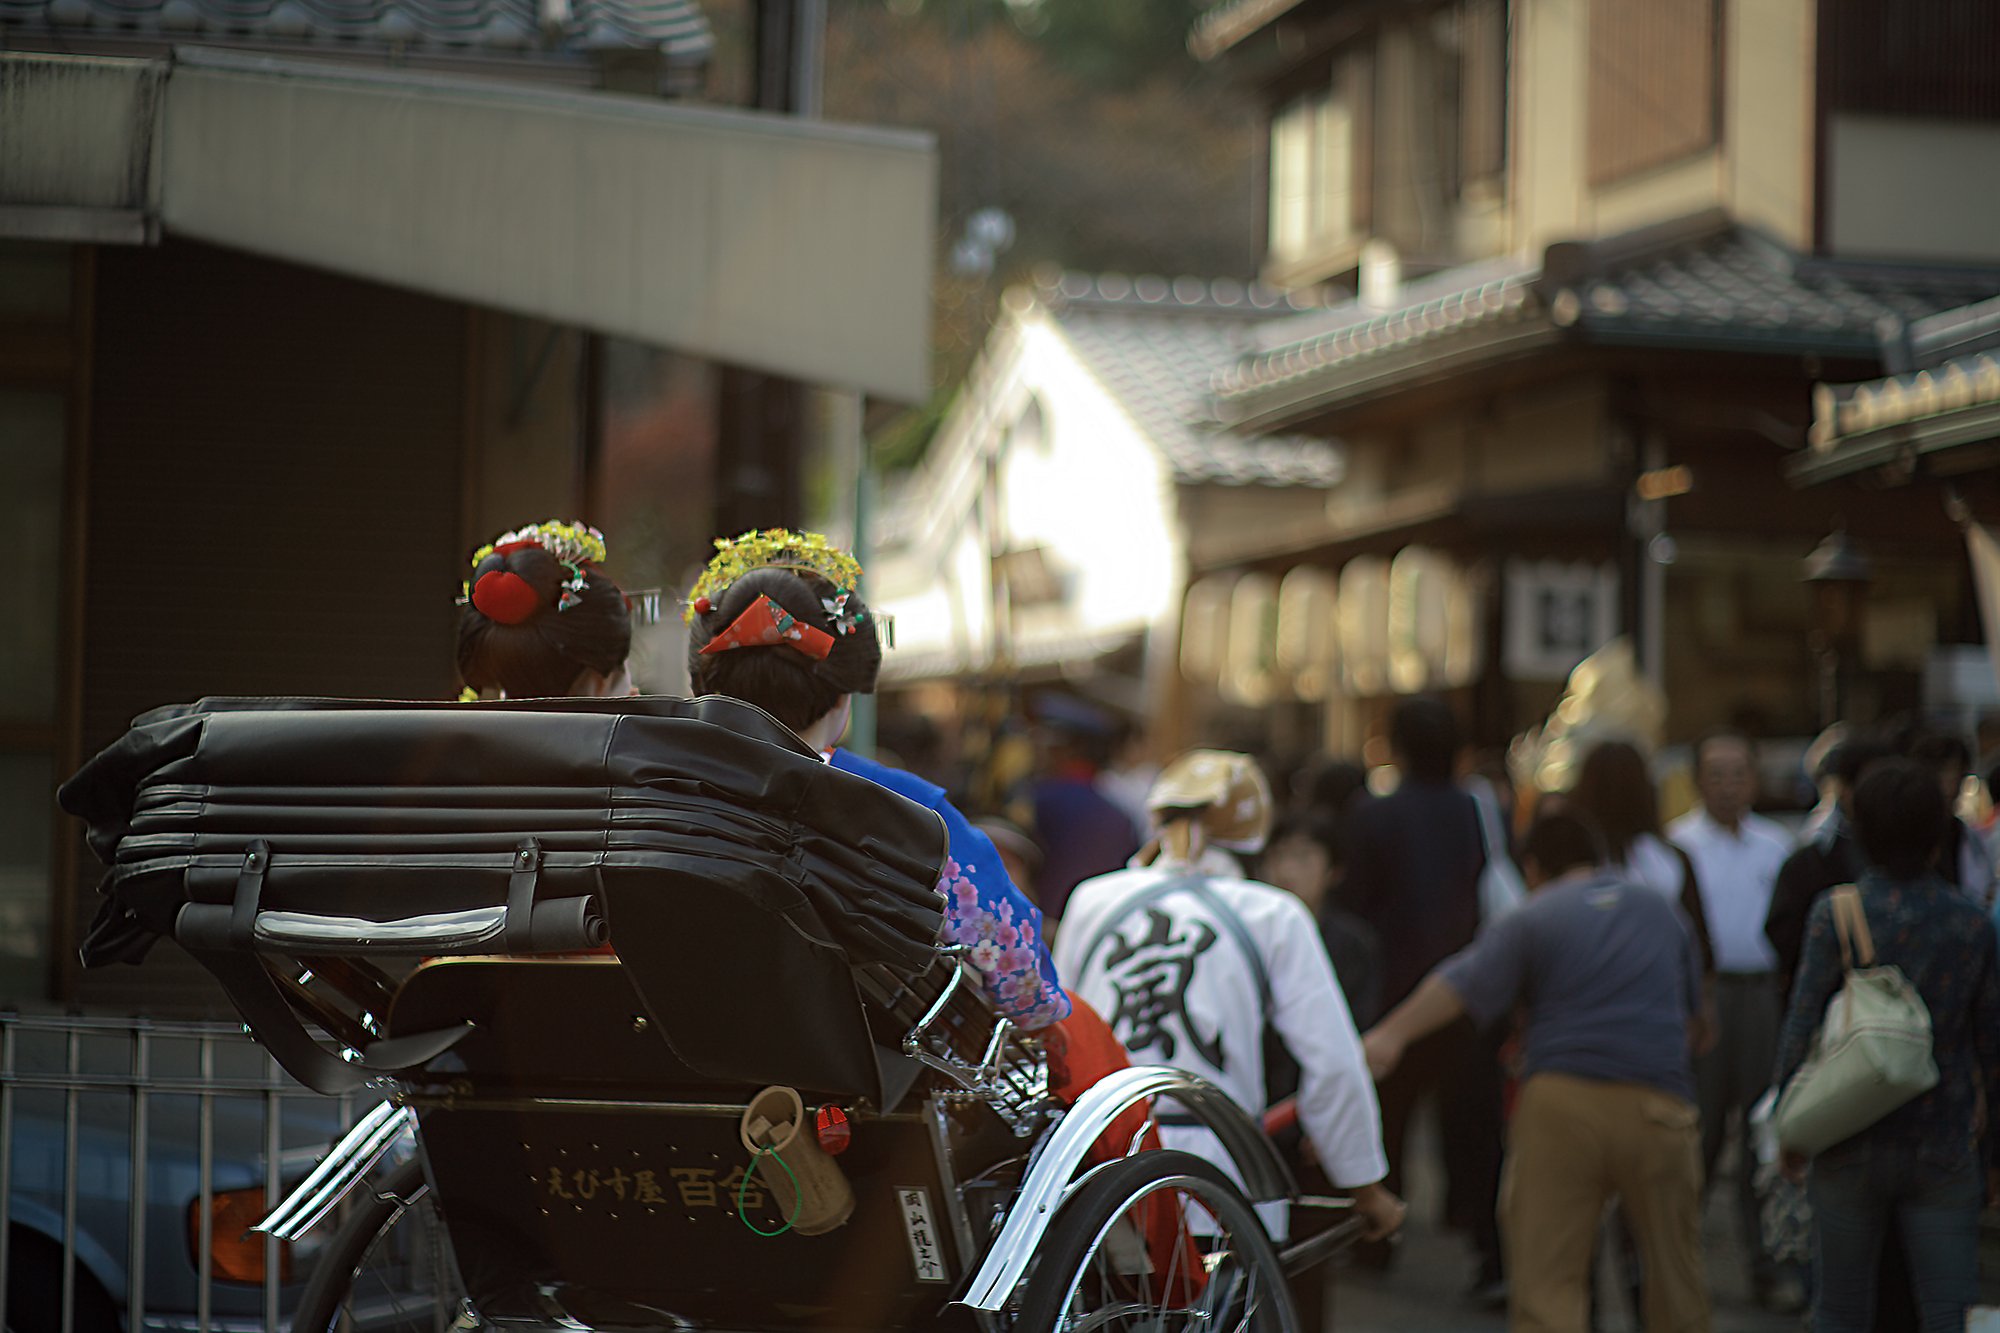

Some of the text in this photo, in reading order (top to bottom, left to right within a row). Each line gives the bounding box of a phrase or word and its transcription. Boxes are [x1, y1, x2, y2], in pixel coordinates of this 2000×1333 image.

[1107, 907, 1225, 1073] 嵐
[547, 1166, 667, 1205] えびす屋
